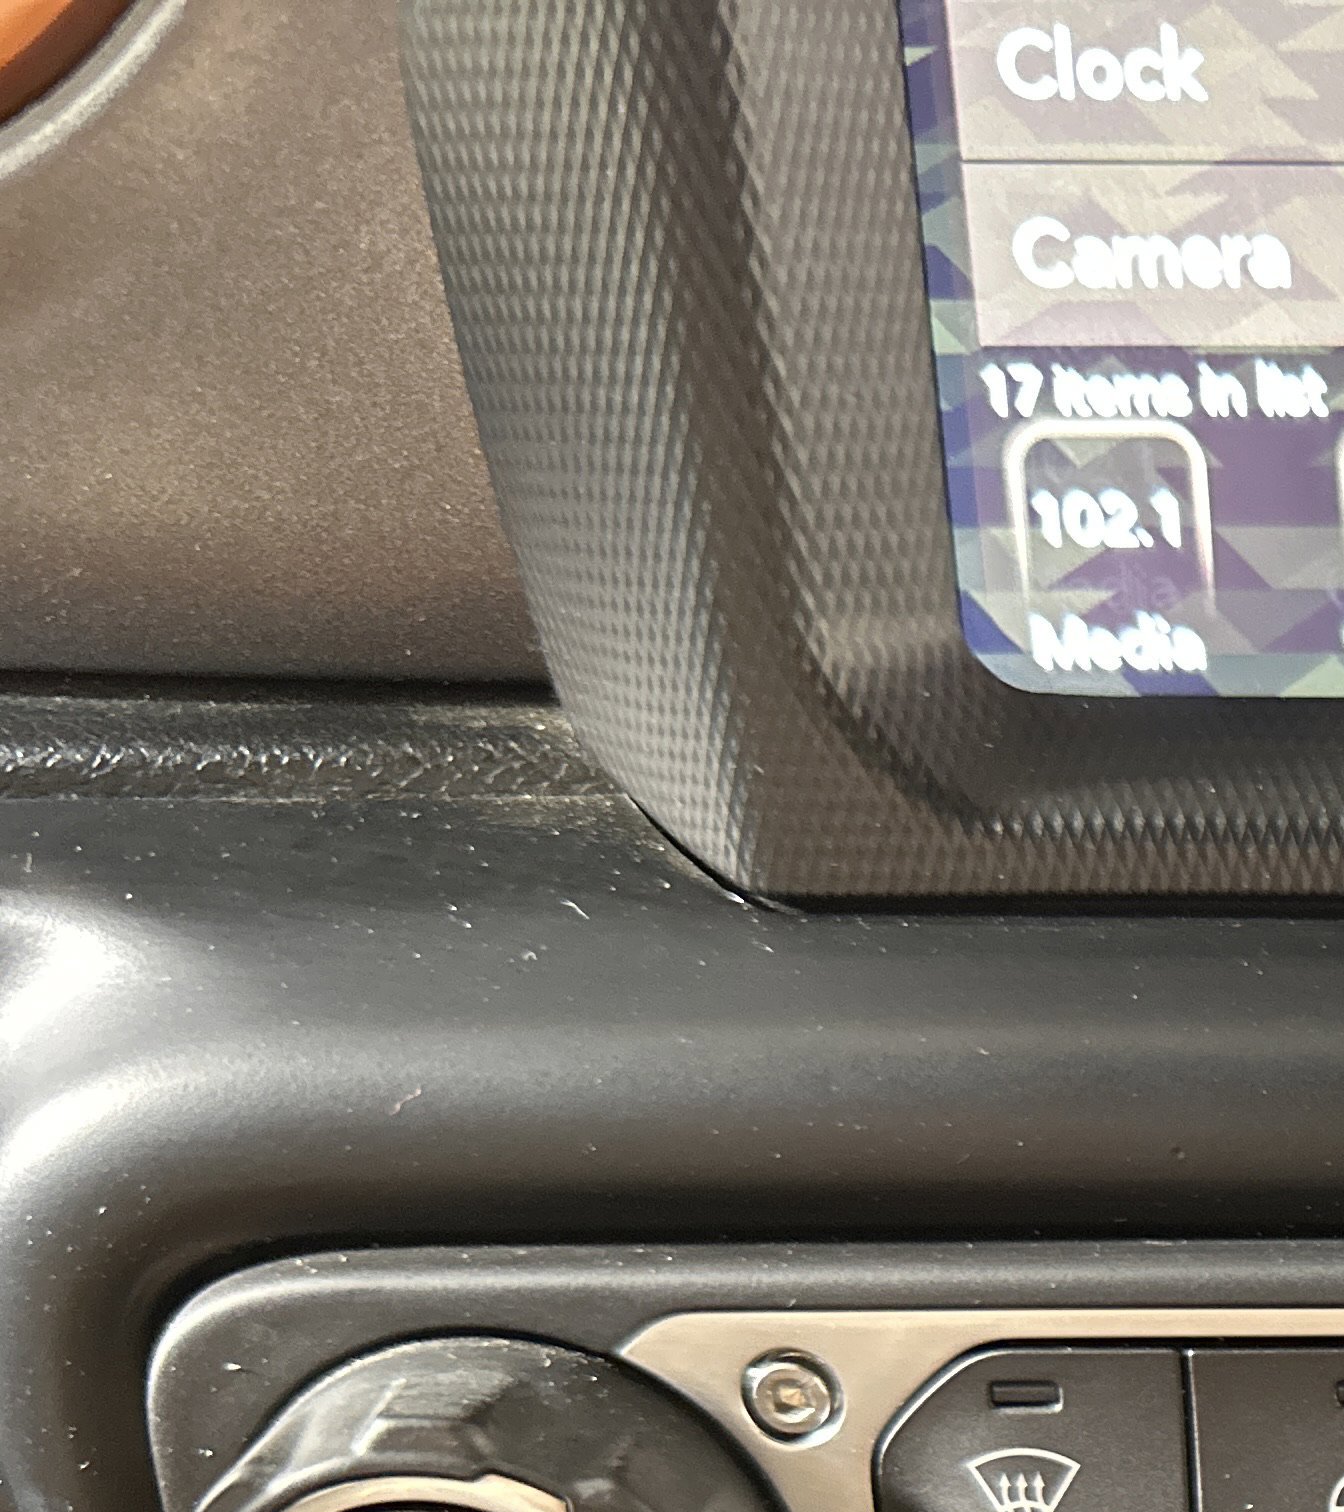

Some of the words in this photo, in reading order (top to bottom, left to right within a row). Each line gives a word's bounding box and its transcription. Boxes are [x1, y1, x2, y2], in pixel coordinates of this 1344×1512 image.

[997, 23, 1208, 102] Clock
[1012, 216, 1292, 290] Camera
[981, 362, 1044, 418] 17
[1051, 361, 1193, 419] items
[1198, 361, 1248, 418] in
[1255, 359, 1330, 418] list
[1031, 488, 1181, 548] 102.1
[1028, 611, 1207, 672] Media
